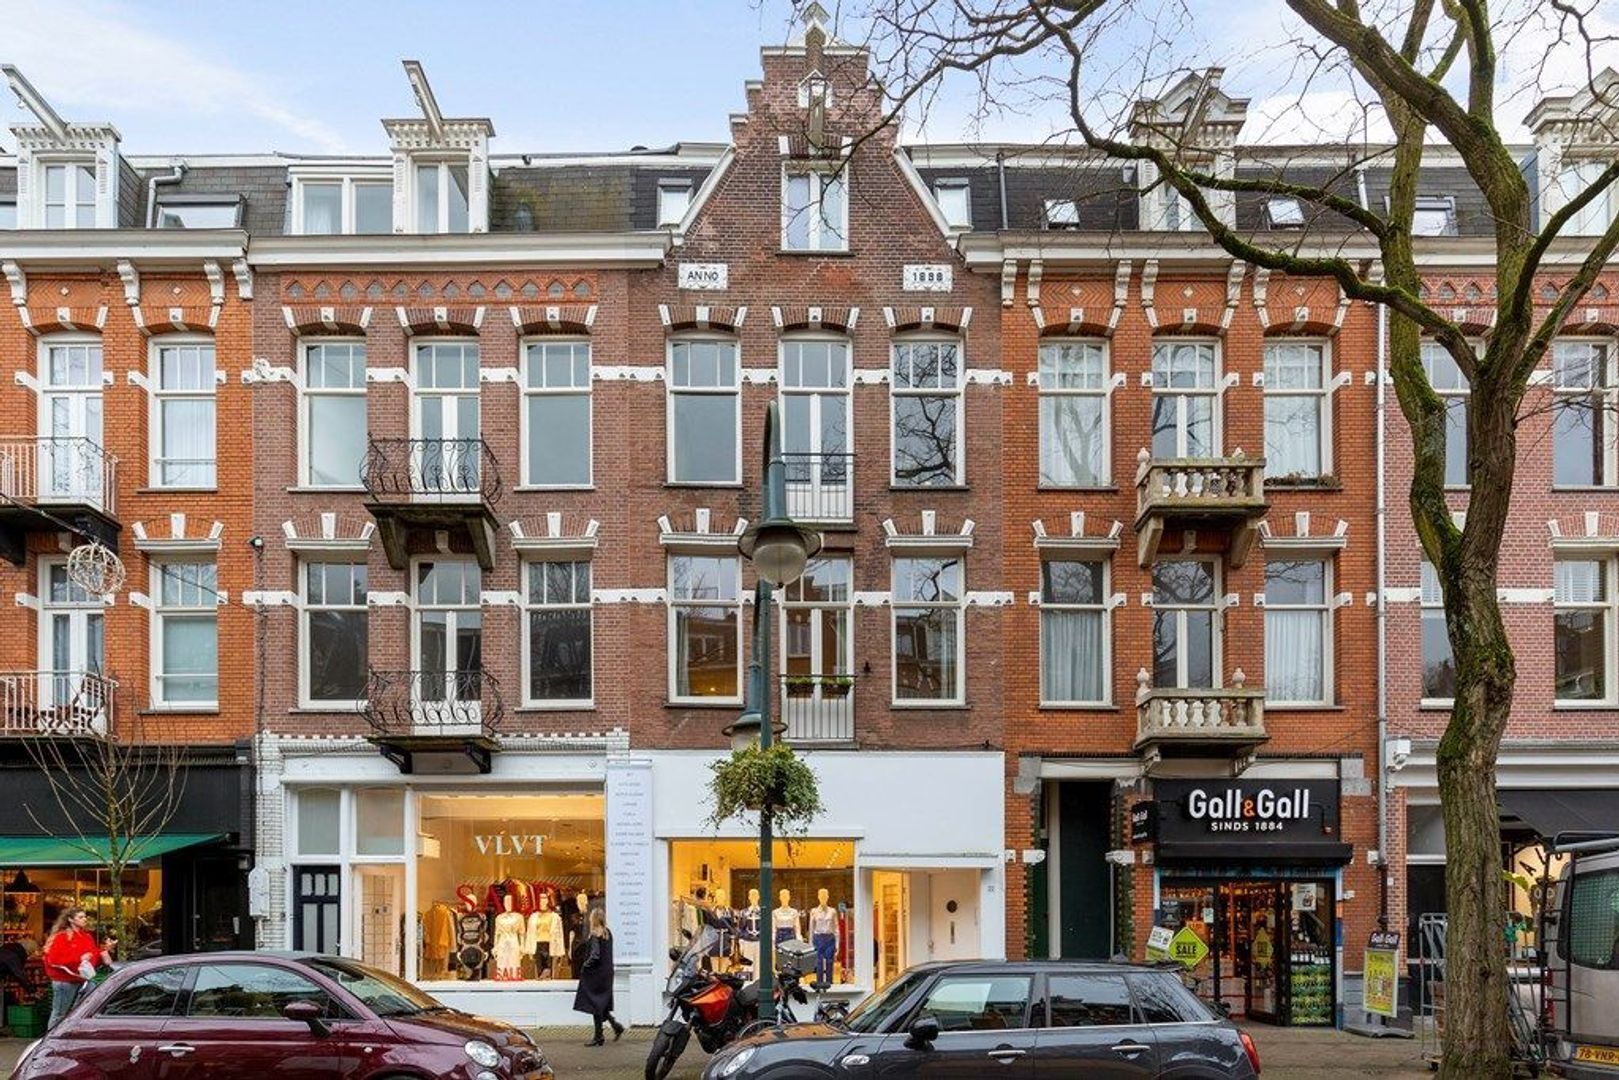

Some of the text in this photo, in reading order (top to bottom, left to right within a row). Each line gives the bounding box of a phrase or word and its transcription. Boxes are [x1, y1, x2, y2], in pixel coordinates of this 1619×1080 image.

[687, 270, 719, 281] ANNO
[1211, 821, 1283, 832] SINDS 1884
[1176, 945, 1197, 955] SALE
